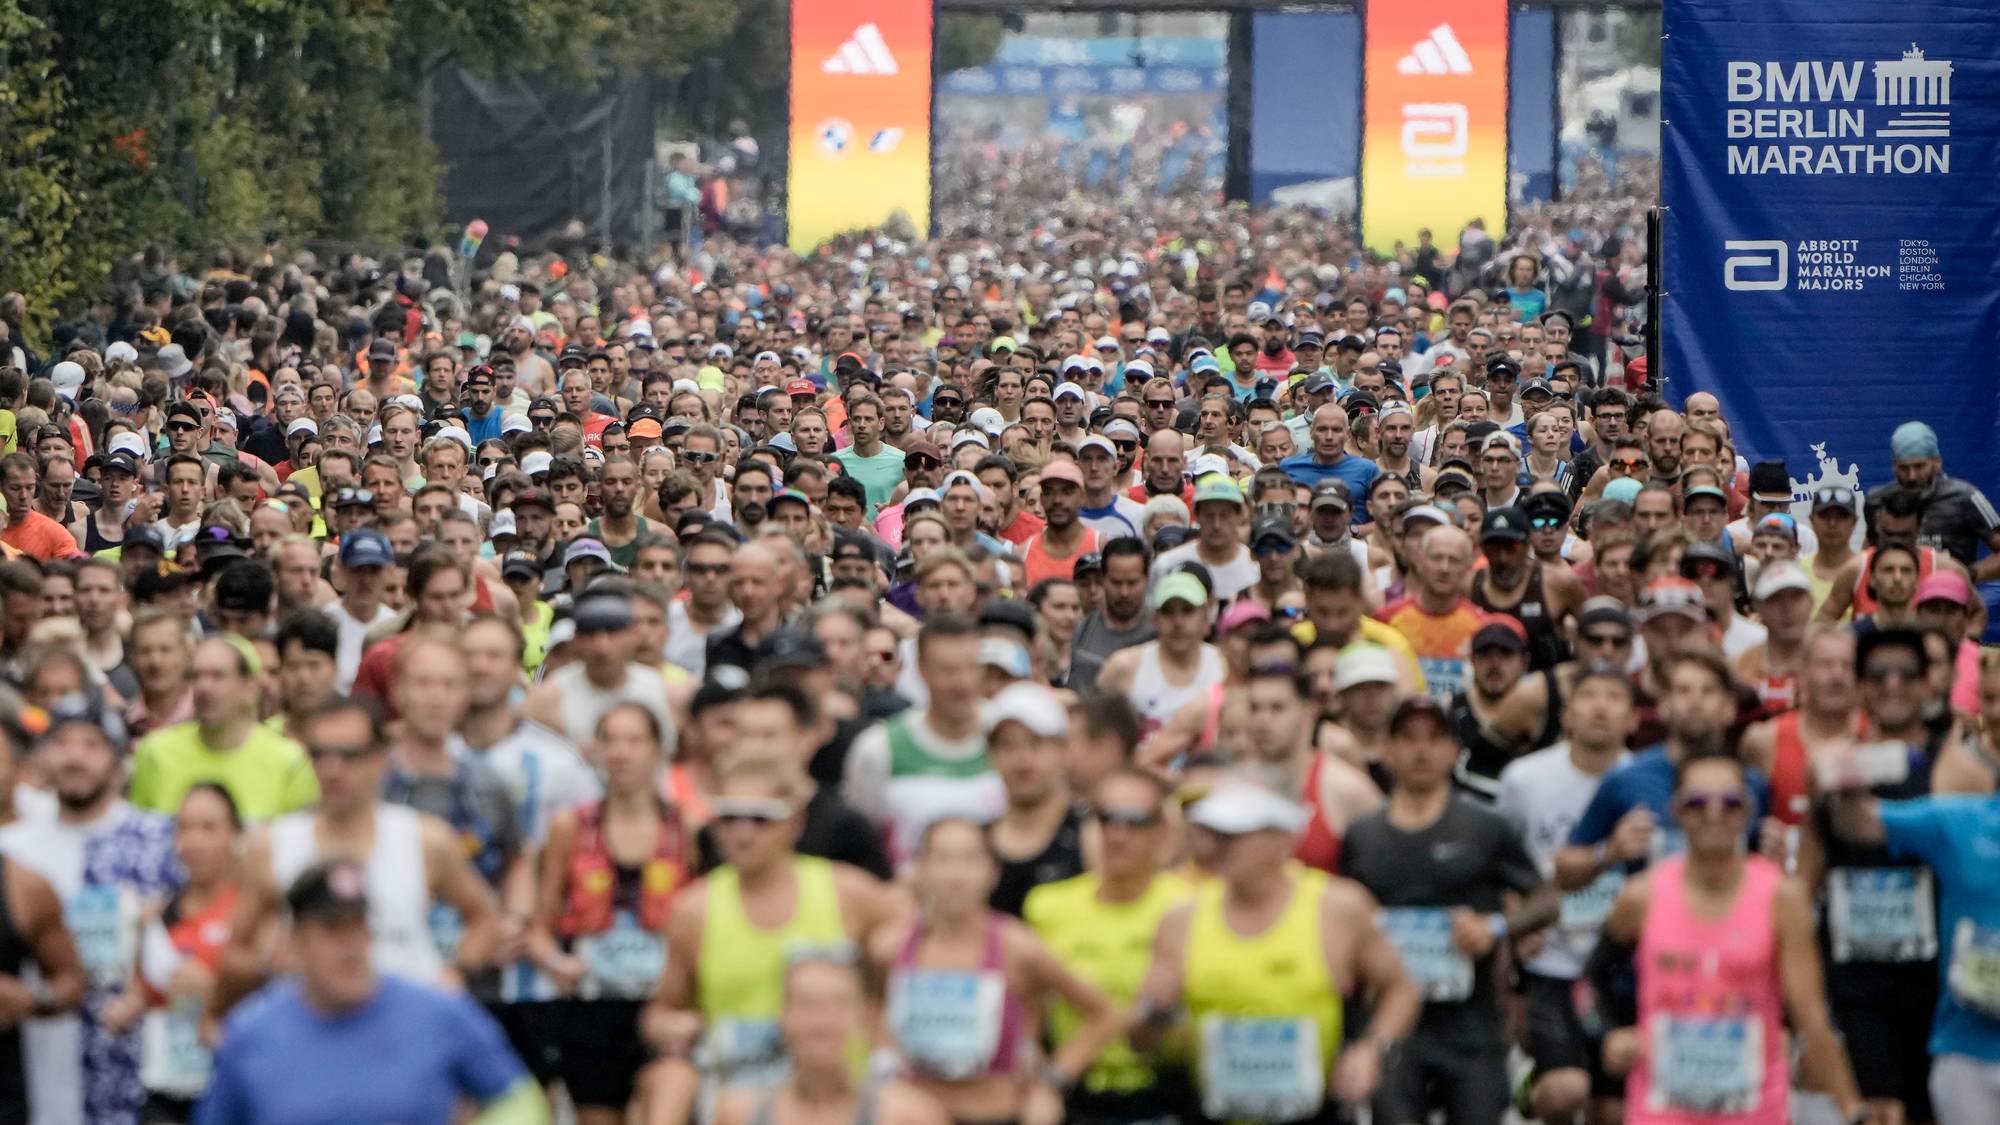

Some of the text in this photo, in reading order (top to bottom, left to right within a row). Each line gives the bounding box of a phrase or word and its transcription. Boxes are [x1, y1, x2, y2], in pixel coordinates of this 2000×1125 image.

[1727, 61, 1865, 103] BMW
[1727, 108, 1865, 139] BERLIN
[1727, 144, 1950, 175] MARATHON
[1797, 239, 1859, 252] ABBOTT
[1900, 239, 1929, 247] TOKYO
[1797, 252, 1855, 264] WORLD
[1900, 248, 1936, 256] BOSTON
[1900, 256, 1938, 264] LONDON
[1797, 265, 1891, 278] MARATHON
[1900, 265, 1930, 273] BERLIN
[1900, 273, 1942, 282] CHICAGO
[1797, 278, 1864, 291] MAJORS
[1900, 282, 1945, 290] NEW YORK
